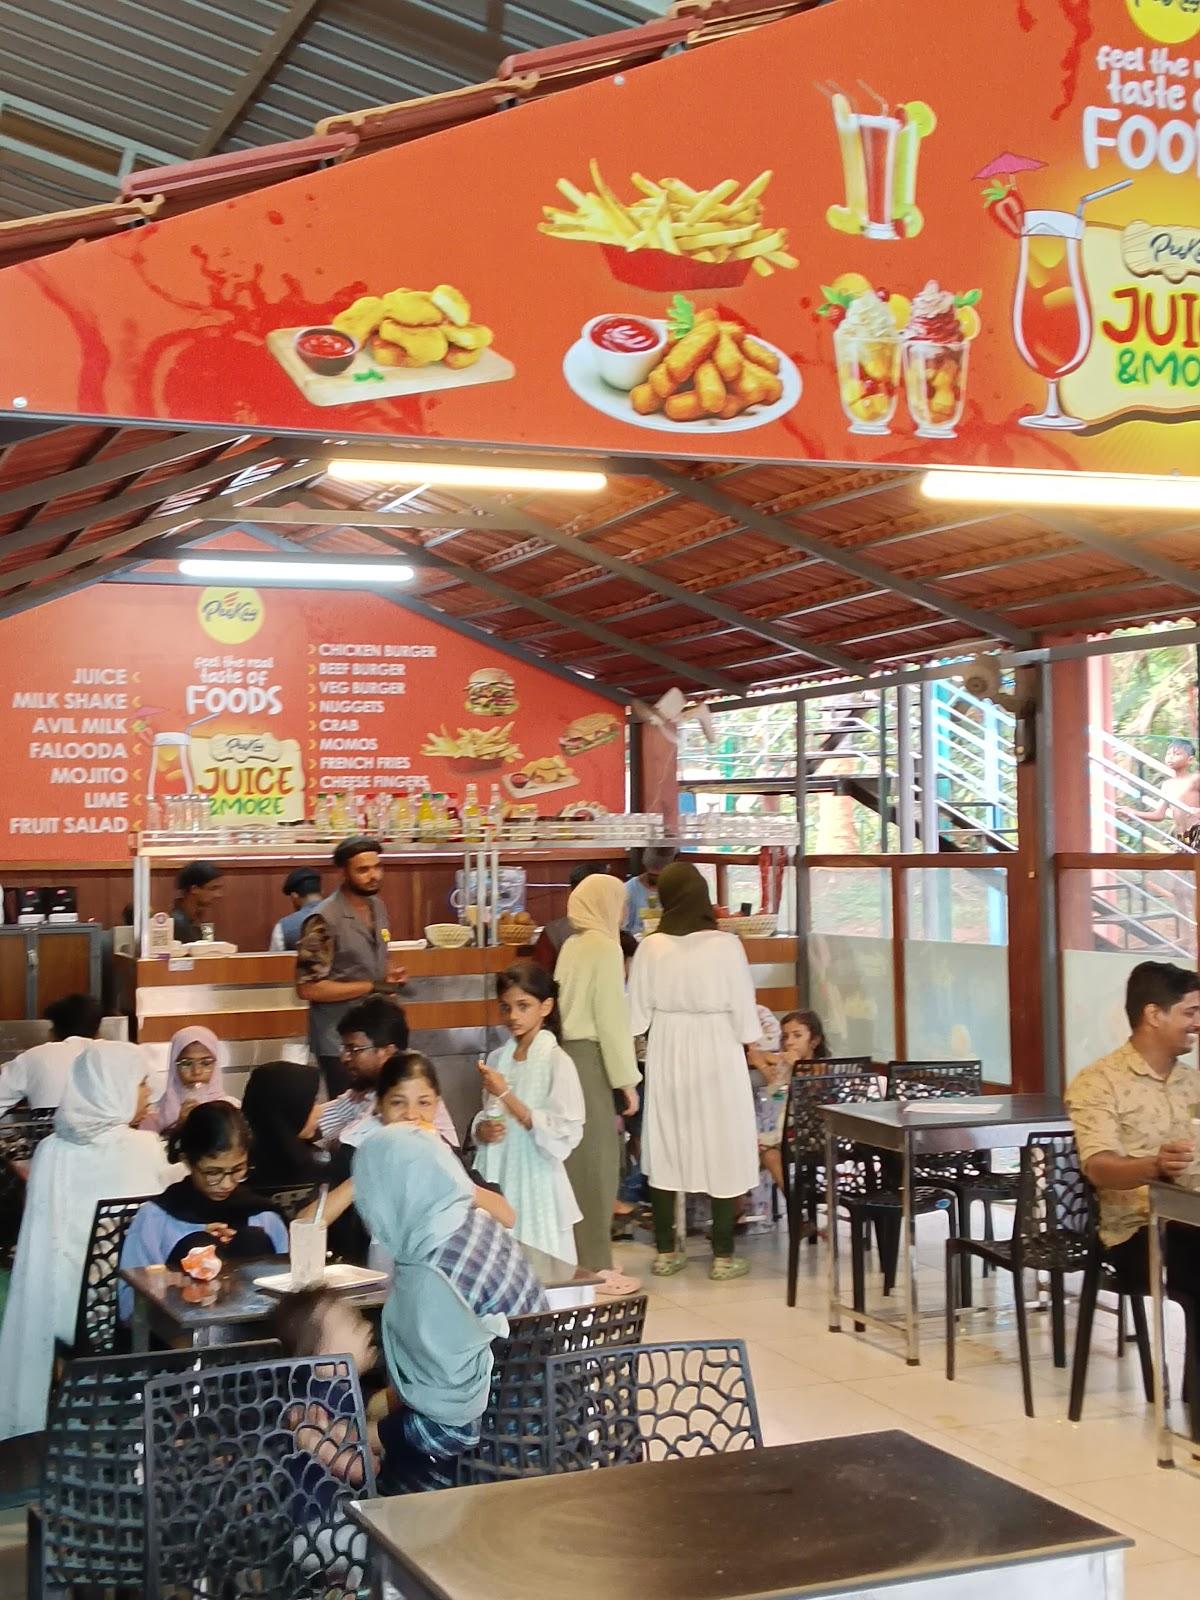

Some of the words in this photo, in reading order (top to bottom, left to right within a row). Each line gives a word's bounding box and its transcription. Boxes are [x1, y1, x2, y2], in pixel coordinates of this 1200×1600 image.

[1096, 45, 1145, 71] feel
[1149, 47, 1190, 77] the
[1106, 69, 1186, 111] taste
[1101, 287, 1200, 348] JUI
[319, 644, 381, 657] CHICKEN
[384, 645, 437, 658] BURGER
[72, 669, 128, 685] JUICE
[200, 668, 243, 684] taste
[246, 669, 268, 686] of
[319, 663, 349, 675] BEEF
[352, 664, 406, 676] BURGER
[319, 682, 349, 695] VEG
[352, 682, 406, 695] BURGER
[12, 692, 60, 709] MILK
[64, 692, 128, 710] SHAKE
[185, 684, 283, 715] FOODS
[319, 701, 385, 714] NUGGETS
[32, 717, 77, 734] AVIL
[81, 717, 128, 734] MILK
[319, 719, 359, 732] CRAB
[29, 742, 128, 759] FALOODA
[319, 738, 378, 751] MOMOS
[320, 757, 375, 770] FRENCH
[377, 757, 411, 769] FRIES
[50, 767, 128, 784] MOJITO
[197, 766, 294, 795] JUICE
[320, 775, 371, 788] CHEESE
[373, 775, 430, 788] FINGERS
[84, 792, 128, 809] LIME
[10, 817, 61, 834] FRUIT
[63, 816, 128, 834] SALAD
